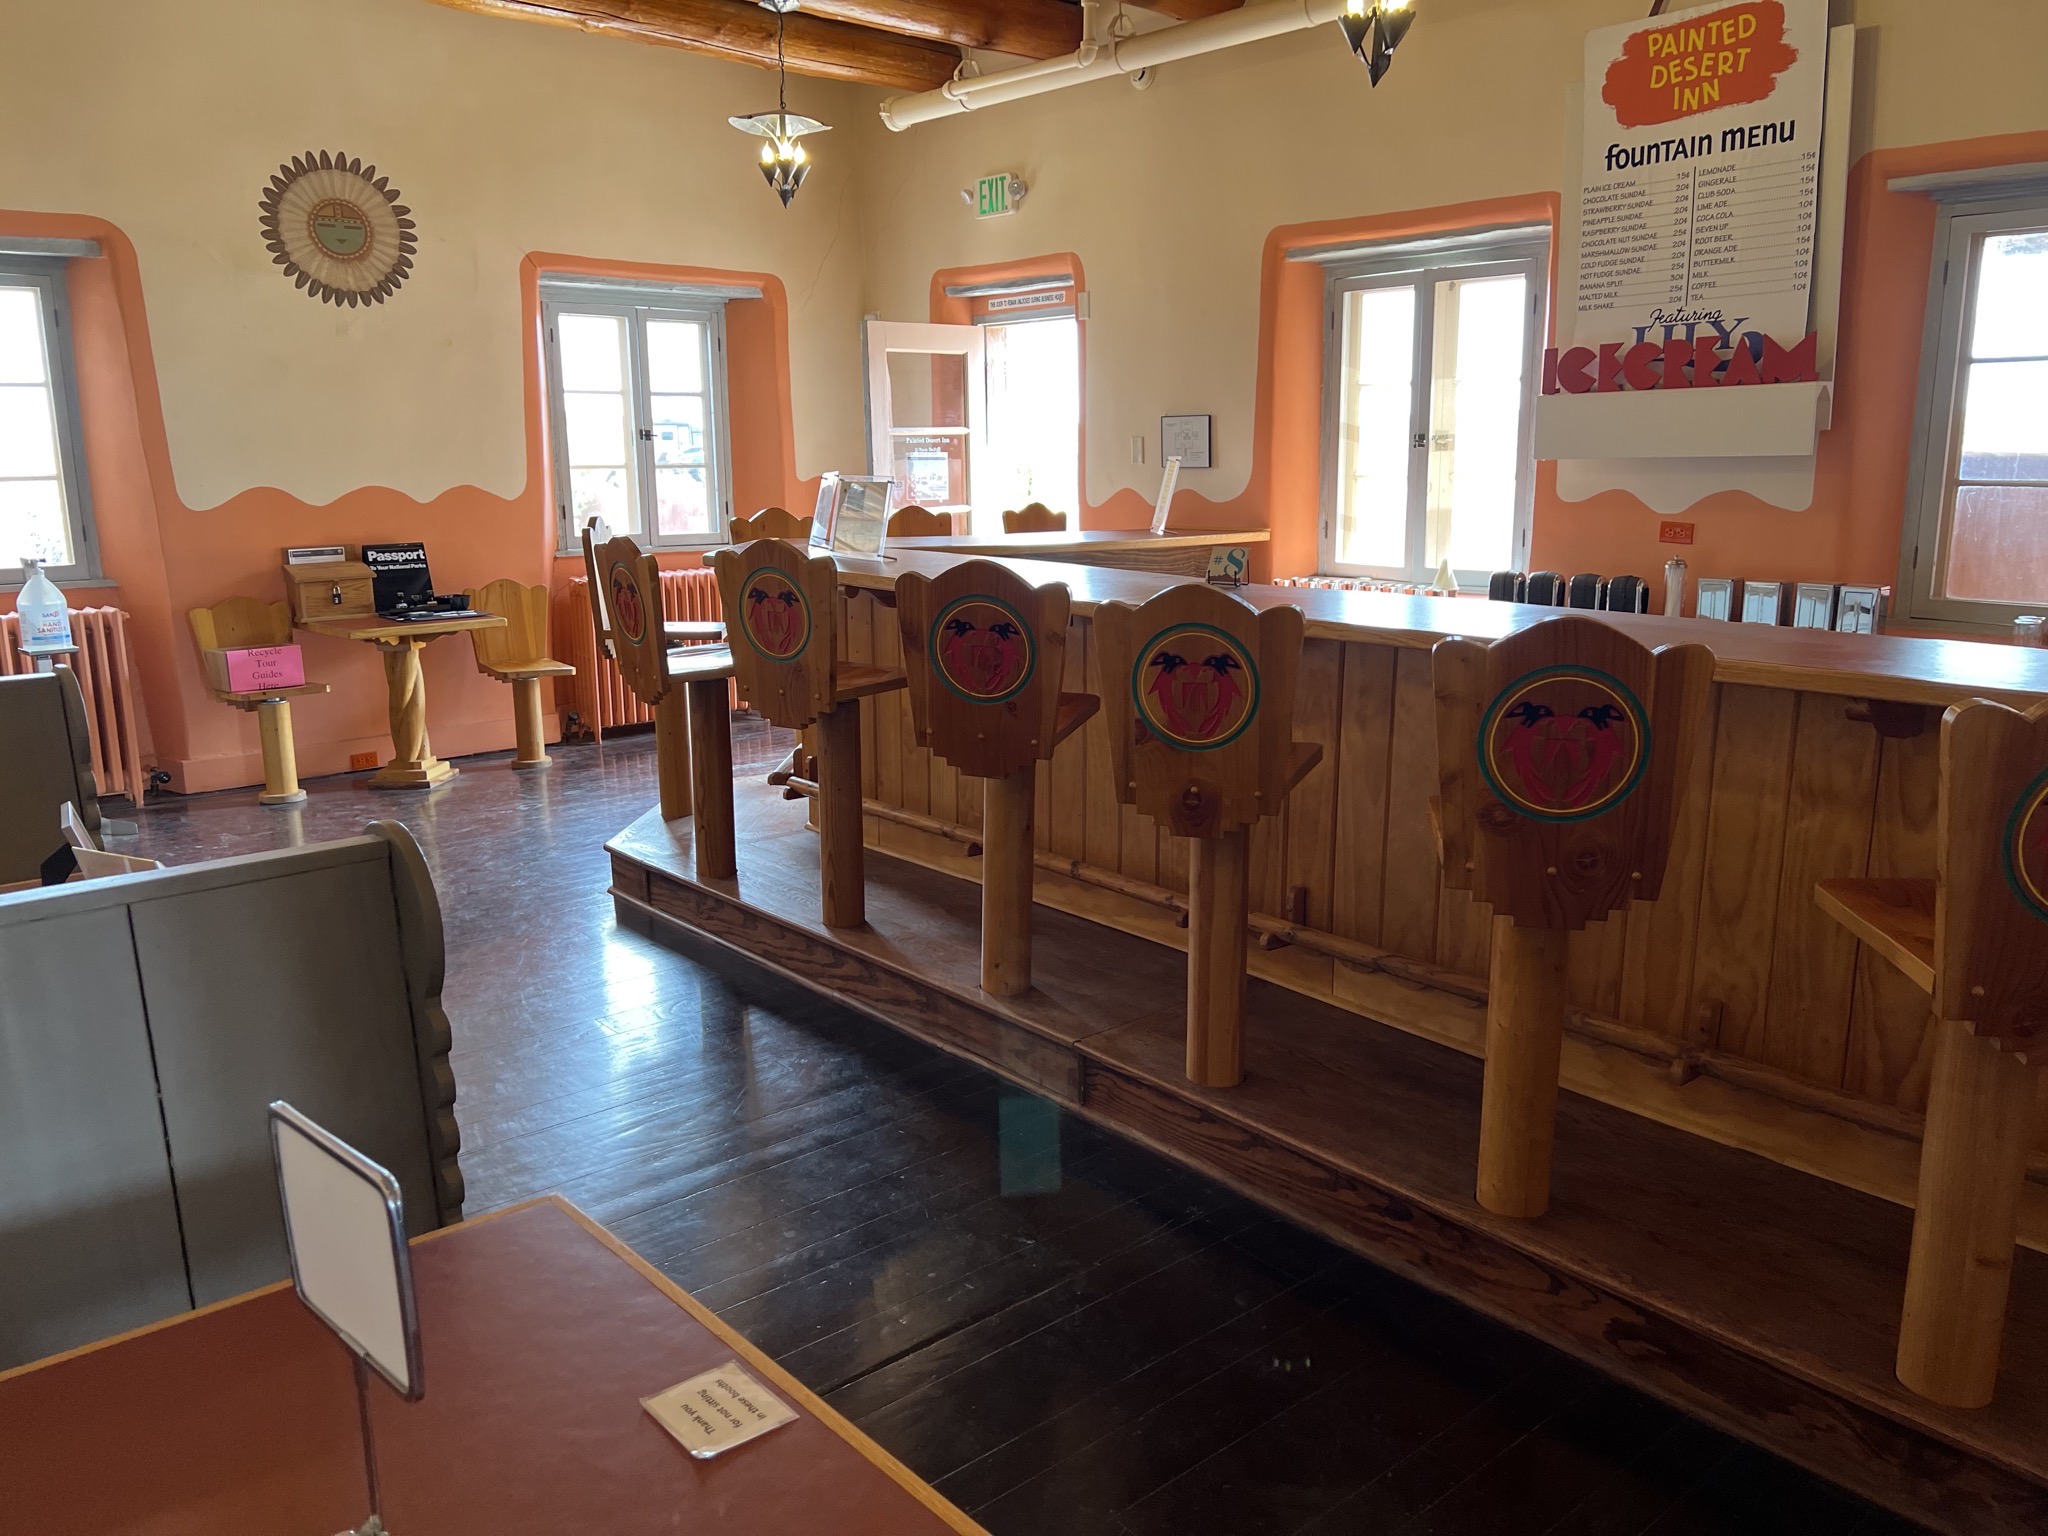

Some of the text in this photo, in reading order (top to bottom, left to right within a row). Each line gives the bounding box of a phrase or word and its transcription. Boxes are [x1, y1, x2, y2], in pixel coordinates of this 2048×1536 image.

[1648, 14, 1756, 58] PAINTED
[1650, 48, 1751, 88] DESERT
[1673, 78, 1720, 111] INN
[1699, 151, 1816, 176] LEMONADE 15¢
[1584, 185, 1600, 194] PLAIN
[1613, 181, 1635, 189] CREAM
[1677, 172, 1689, 180] 15¢
[1698, 164, 1815, 188] GINGERALE 15¢
[979, 176, 1006, 214] EXIT
[1583, 193, 1619, 204] CHOCOLATE
[1620, 190, 1646, 199] SUNDAE
[1698, 176, 1814, 200] CLUB SODA 15¢
[1583, 195, 1688, 216] STRAWBERRY SUNDAE 20¢
[1697, 188, 1814, 211] LIME ADE 15¢
[1583, 216, 1615, 226] PINEAPPLE
[1617, 213, 1642, 222] SUNDAE
[1697, 200, 1813, 222] COCA COLA 10¢
[1582, 227, 1620, 237] RASPBERRY
[1621, 223, 1647, 232] SUNDAE
[1696, 225, 1718, 234] SEVEN
[1798, 212, 1812, 220] 10¢
[1582, 229, 1686, 248] CHOCOLATE NUT SUNDAE 25¢
[1695, 224, 1811, 245] ROOT BEER 10¢
[1582, 240, 1686, 259] MARSHMALLOW SUNDAE 20¢
[1694, 247, 1724, 256] ORANGE
[1796, 236, 1810, 244] 15¢
[1581, 261, 1597, 269] COLD
[1598, 259, 1618, 268] FUDGE
[1620, 256, 1645, 265] SUNDAE
[1693, 248, 1810, 268] BUTTERMILK 10¢
[1581, 272, 1593, 280] HOT
[1594, 270, 1614, 279] FUDGE
[1615, 267, 1641, 276] SUNDAE
[1693, 260, 1808, 279] MILK 10¢
[1580, 282, 1605, 291] BANANA
[1606, 280, 1623, 288] SPLIT
[1692, 281, 1718, 290] COFFEE
[1792, 283, 1807, 291] 10¢
[1579, 293, 1603, 301] MALTED
[1593, 302, 1614, 310] SHAKE
[1649, 305, 1723, 331] Featuring
[367, 550, 425, 562] Passport
[248, 648, 282, 657] Recycle
[256, 660, 277, 668] Tour
[252, 671, 283, 680] Guides
[715, 1379, 740, 1399] booths
[697, 1389, 743, 1428] for not sitting
[738, 1397, 759, 1414] these
[681, 1404, 716, 1435] Thank you
